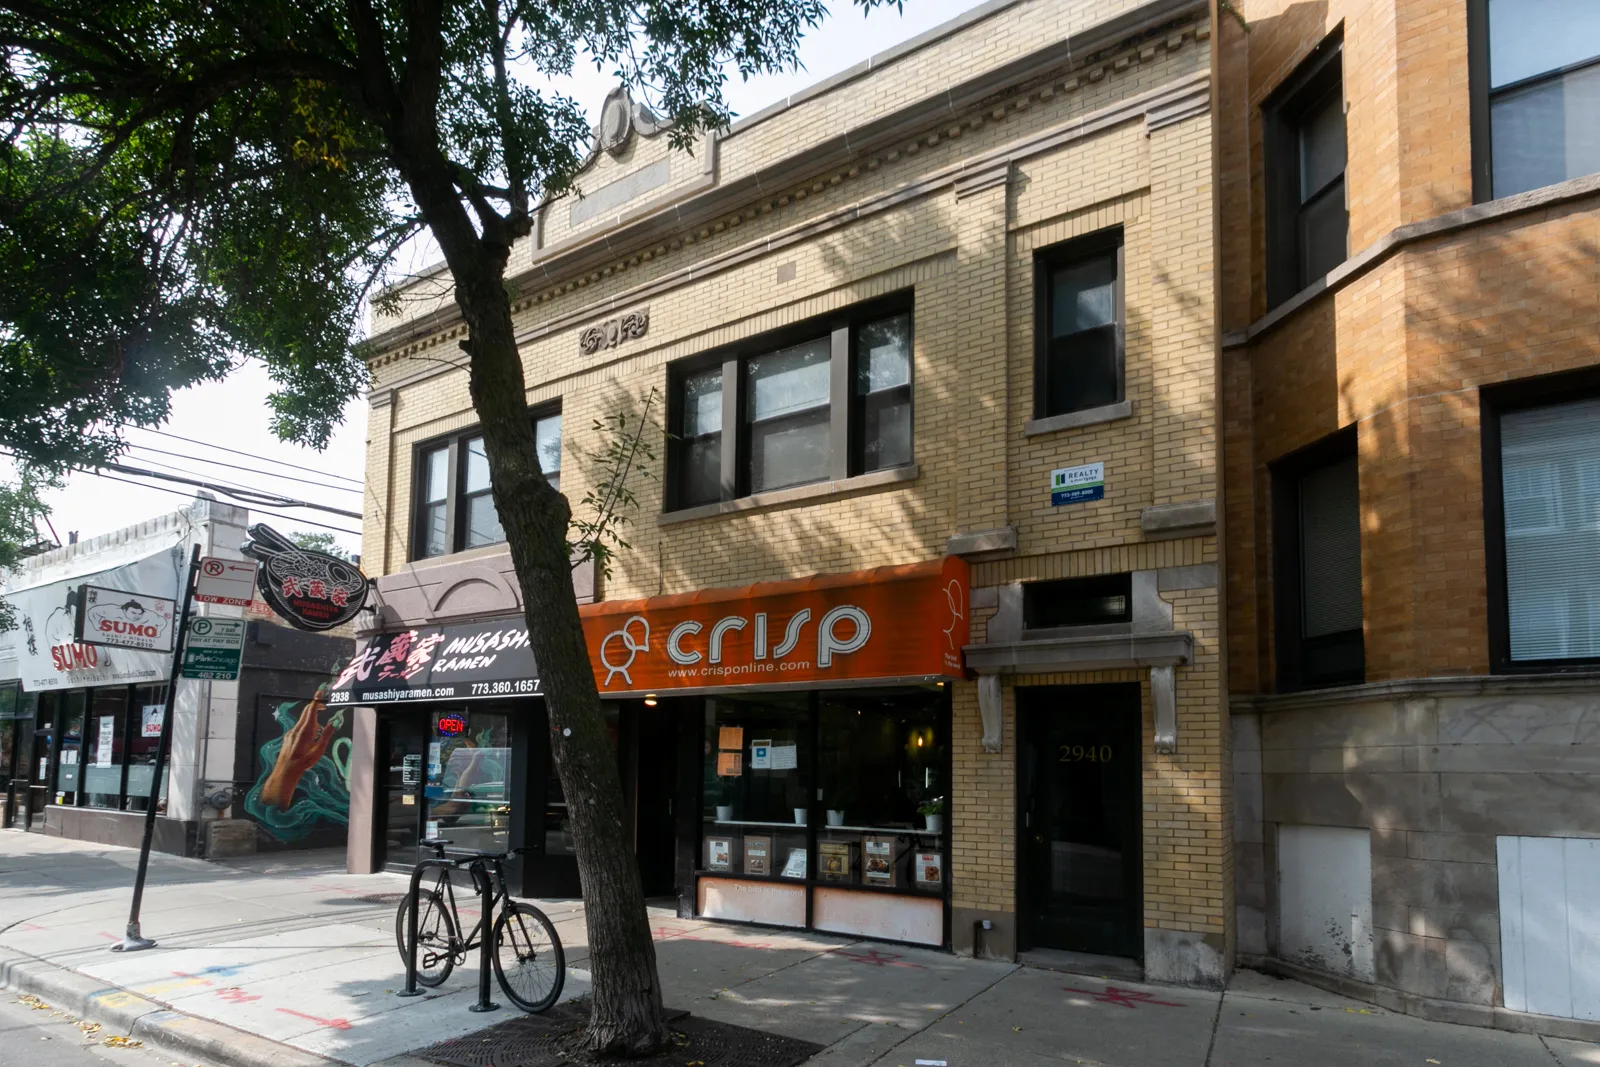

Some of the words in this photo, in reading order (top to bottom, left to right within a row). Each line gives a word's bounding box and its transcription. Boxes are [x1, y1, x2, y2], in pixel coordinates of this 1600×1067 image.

[1068, 469, 1099, 479] REALTY
[200, 595, 219, 603] TOW
[293, 599, 339, 613] MUSASHIYA
[302, 608, 330, 619] RAMEN
[99, 619, 158, 638] SUMO
[666, 604, 872, 668] crisp
[105, 637, 154, 649] 773-477-8510
[51, 643, 98, 672] SUMO
[195, 655, 238, 665] ParkChicago
[431, 654, 497, 673] RAMEN
[215, 672, 233, 680] 210
[668, 661, 810, 678] www.crisponline.com
[66, 674, 83, 684] Sushi
[330, 691, 350, 702] 2938
[362, 687, 454, 701] musashiyaramen.com
[471, 679, 540, 695] 773.360.1657
[145, 723, 161, 733] SUMO
[439, 718, 464, 732] OPEN
[1059, 745, 1112, 763] 2940
[733, 883, 747, 892] The
